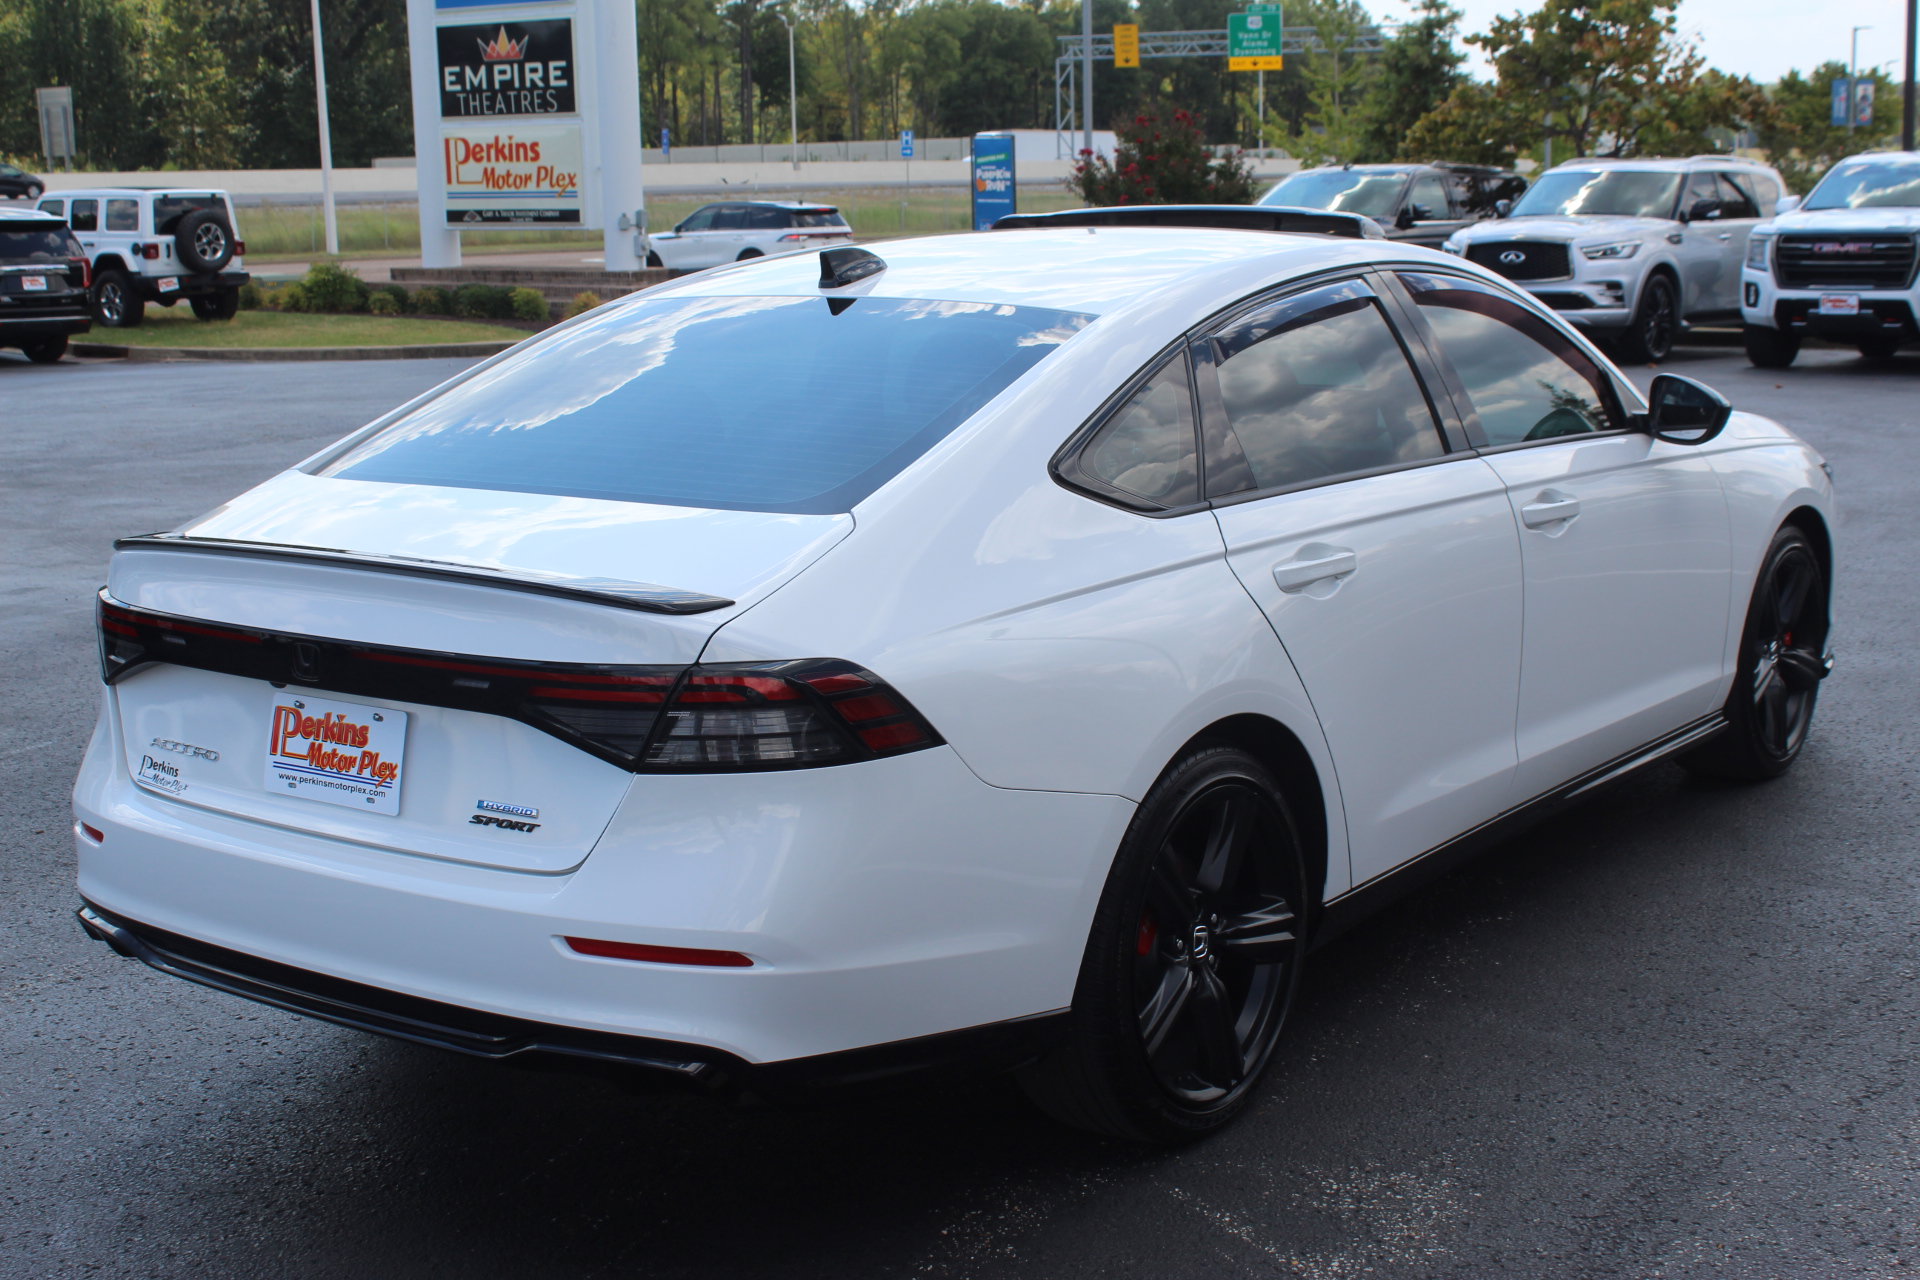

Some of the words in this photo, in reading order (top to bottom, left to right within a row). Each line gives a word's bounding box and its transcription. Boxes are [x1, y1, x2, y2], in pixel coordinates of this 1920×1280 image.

[444, 61, 568, 92] EMPIRE
[456, 89, 558, 116] THEATRES
[902, 130, 912, 145] H
[444, 136, 541, 185] Perkins
[481, 166, 533, 190] Motor
[535, 165, 578, 198] Plex
[270, 704, 370, 756] Perkins
[150, 737, 222, 762] ACCORD
[138, 754, 180, 778] Perkins
[306, 741, 359, 773] Motor
[356, 749, 399, 788] Plex
[151, 773, 172, 786] Motor
[278, 771, 387, 798] www.perkinsmotorplex.com
[485, 802, 535, 817] HYBRID
[468, 814, 542, 833] SPORT
